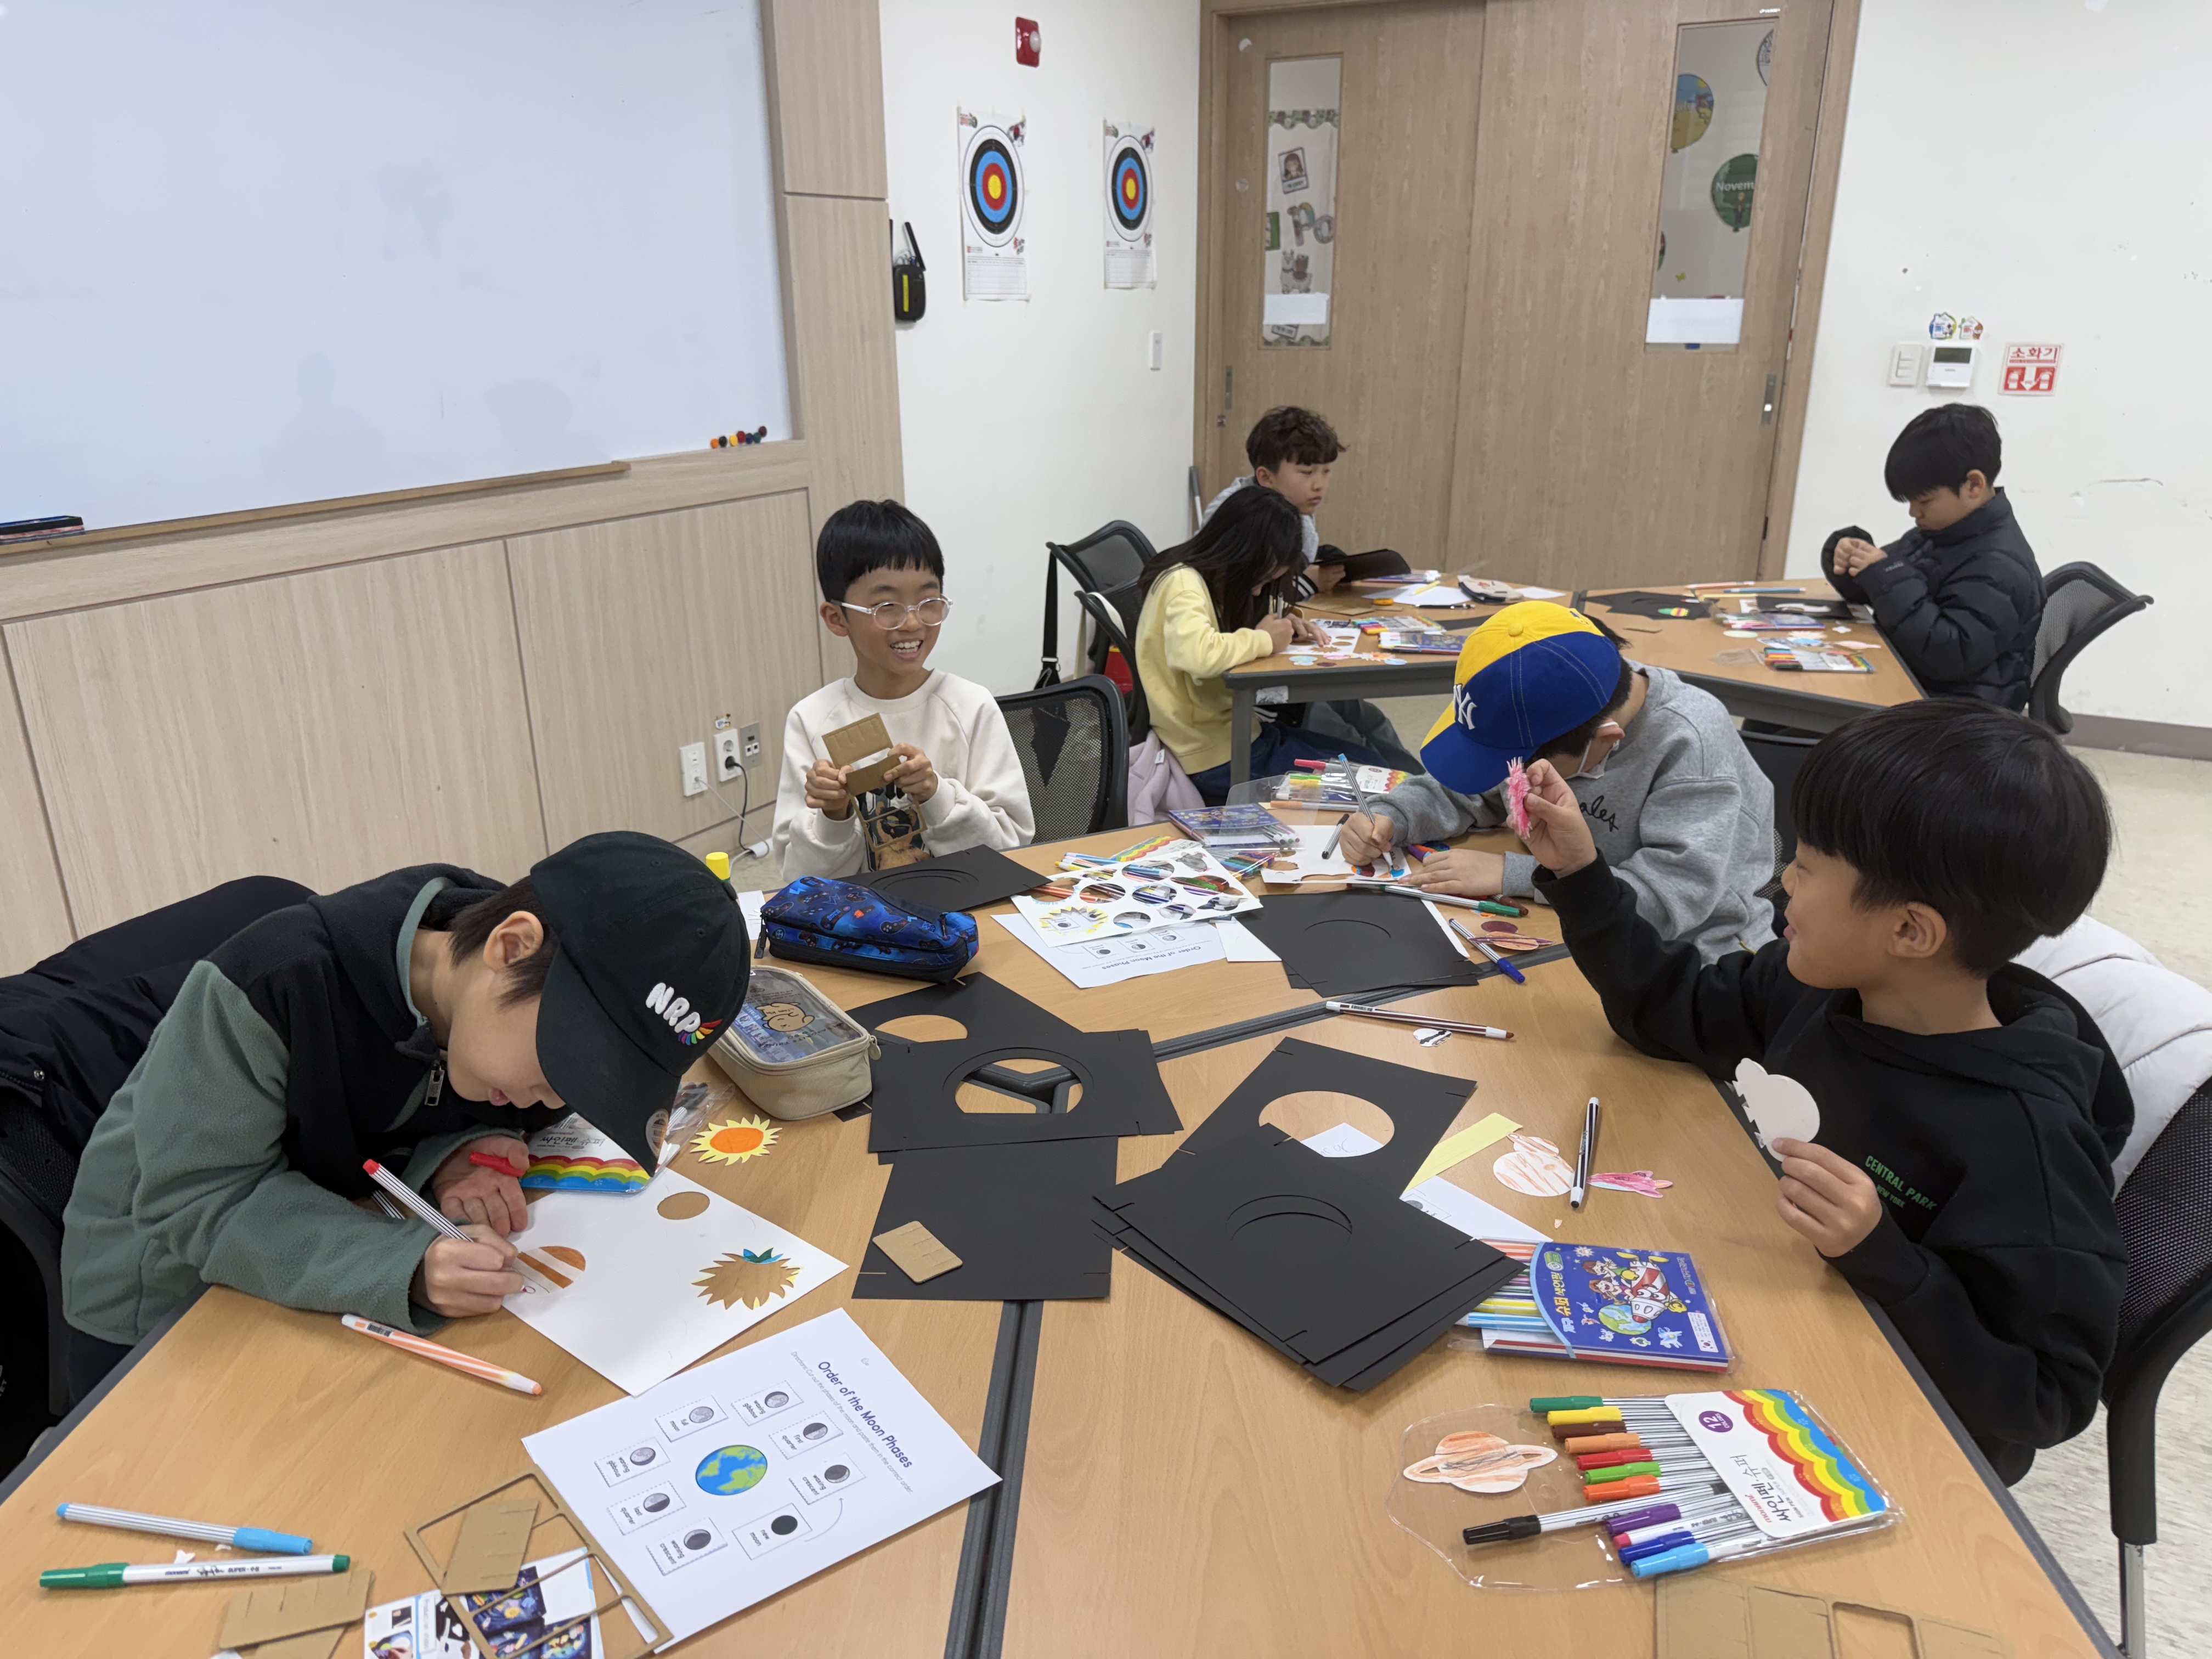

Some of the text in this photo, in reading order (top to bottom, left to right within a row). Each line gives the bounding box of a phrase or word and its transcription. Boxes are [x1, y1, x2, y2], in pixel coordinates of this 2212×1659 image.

[2010, 347, 2057, 364] 소화기
[1102, 960, 1130, 970] Phases
[1131, 955, 1153, 963] Moon
[540, 1137, 578, 1145] 싸인펜
[1865, 1155, 1937, 1210] CENTRAL PARK
[1876, 1184, 1905, 1208] NEW YORK
[1551, 1272, 1565, 1296] 색연필
[1553, 1296, 1572, 1316] 슈퍼
[742, 1403, 758, 1418] gibbous
[753, 1400, 766, 1415] waxing
[818, 1362, 912, 1468] Order of the Moon Phases
[669, 1420, 680, 1432] moon
[1703, 1416, 1722, 1429] 12
[1715, 1413, 1730, 1429] COLORS
[794, 1434, 804, 1444] first
[822, 1387, 836, 1402] phases
[843, 1413, 854, 1425] moon
[853, 1423, 861, 1434] and
[857, 1431, 870, 1443] paste
[868, 1441, 879, 1453] them
[881, 1455, 889, 1465] the
[887, 1464, 902, 1482] correct
[782, 1435, 797, 1451] quarter
[606, 1460, 621, 1477] gibbous
[618, 1457, 630, 1473] waning
[802, 1476, 820, 1496] crescent
[812, 1474, 827, 1491] waxing
[620, 1507, 636, 1525] quarter
[634, 1506, 643, 1516] last
[749, 1532, 761, 1547] moon
[760, 1529, 770, 1540] new
[660, 1543, 678, 1565] crescent
[671, 1540, 685, 1559] waning
